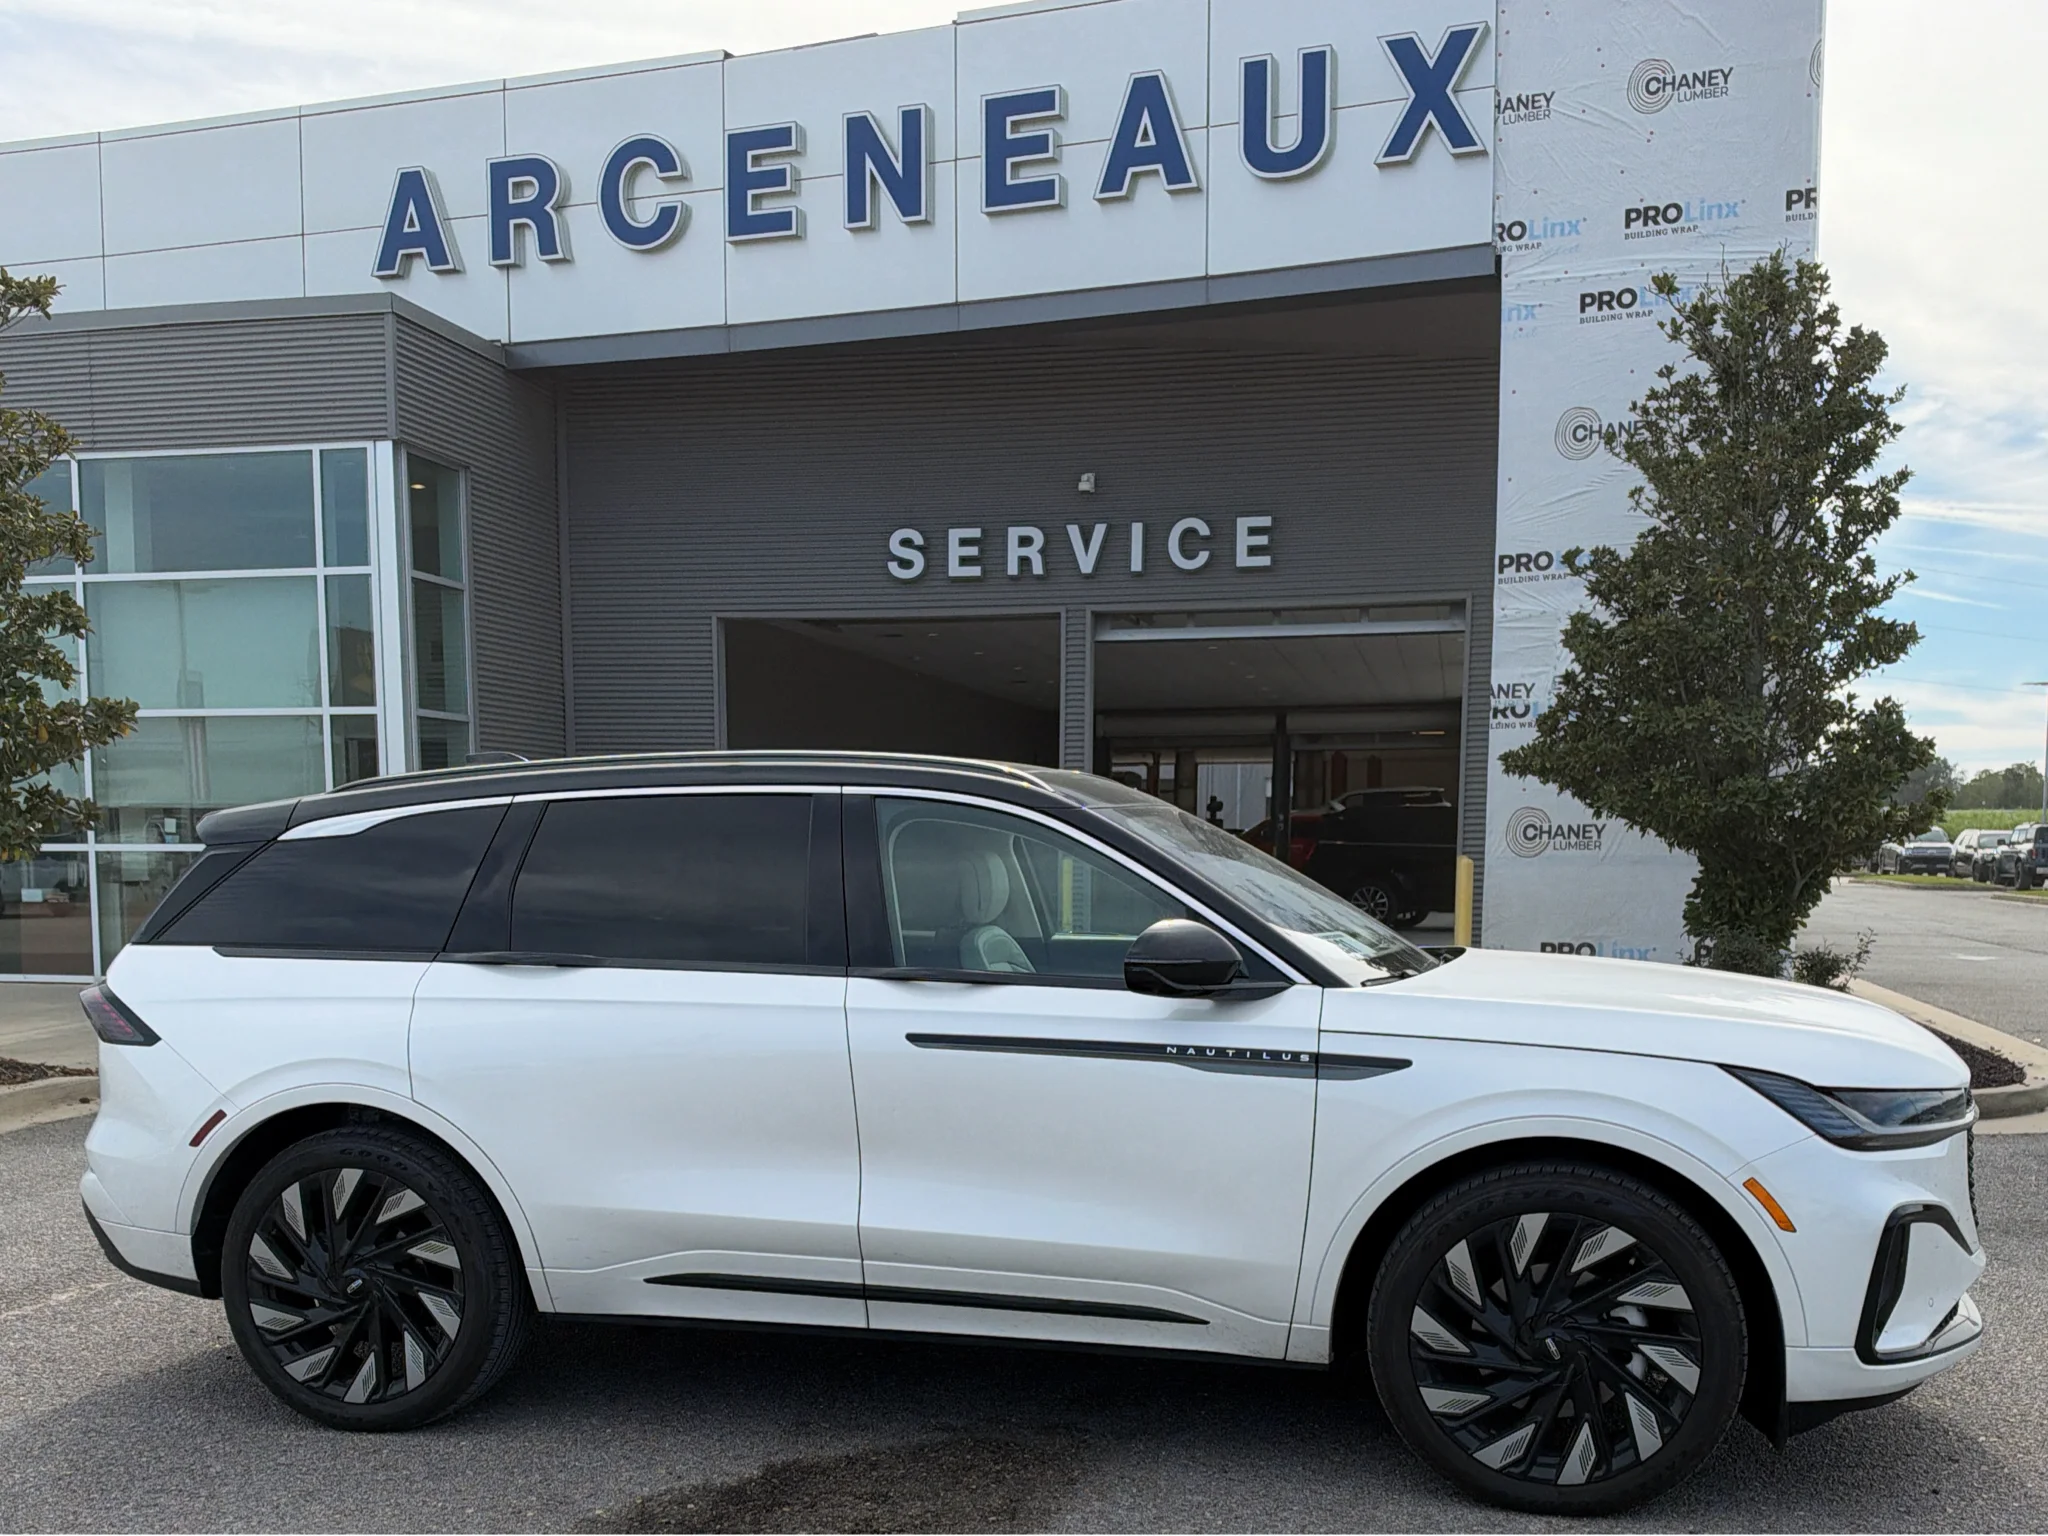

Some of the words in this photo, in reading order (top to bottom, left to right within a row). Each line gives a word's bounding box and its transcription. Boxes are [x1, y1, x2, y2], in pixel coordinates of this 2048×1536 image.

[1644, 66, 1734, 96] CHANEY
[1677, 86, 1729, 103] LUMBER
[1502, 109, 1551, 126] LUMBER
[371, 20, 1489, 279] ARCENEAUX
[1624, 229, 1669, 240] BUILDING
[1671, 225, 1699, 235] WRAP
[1515, 242, 1542, 252] WRAP
[1579, 313, 1623, 325] BUILDING
[1626, 310, 1654, 319] WRAP
[1572, 420, 1646, 443] CHANE
[887, 515, 1273, 581] SERVICE
[1497, 575, 1540, 585] BUILDING
[1522, 823, 1607, 842] CHANEY
[1553, 840, 1602, 851] LUMBER
[1166, 1046, 1310, 1062] NAUTILUS
